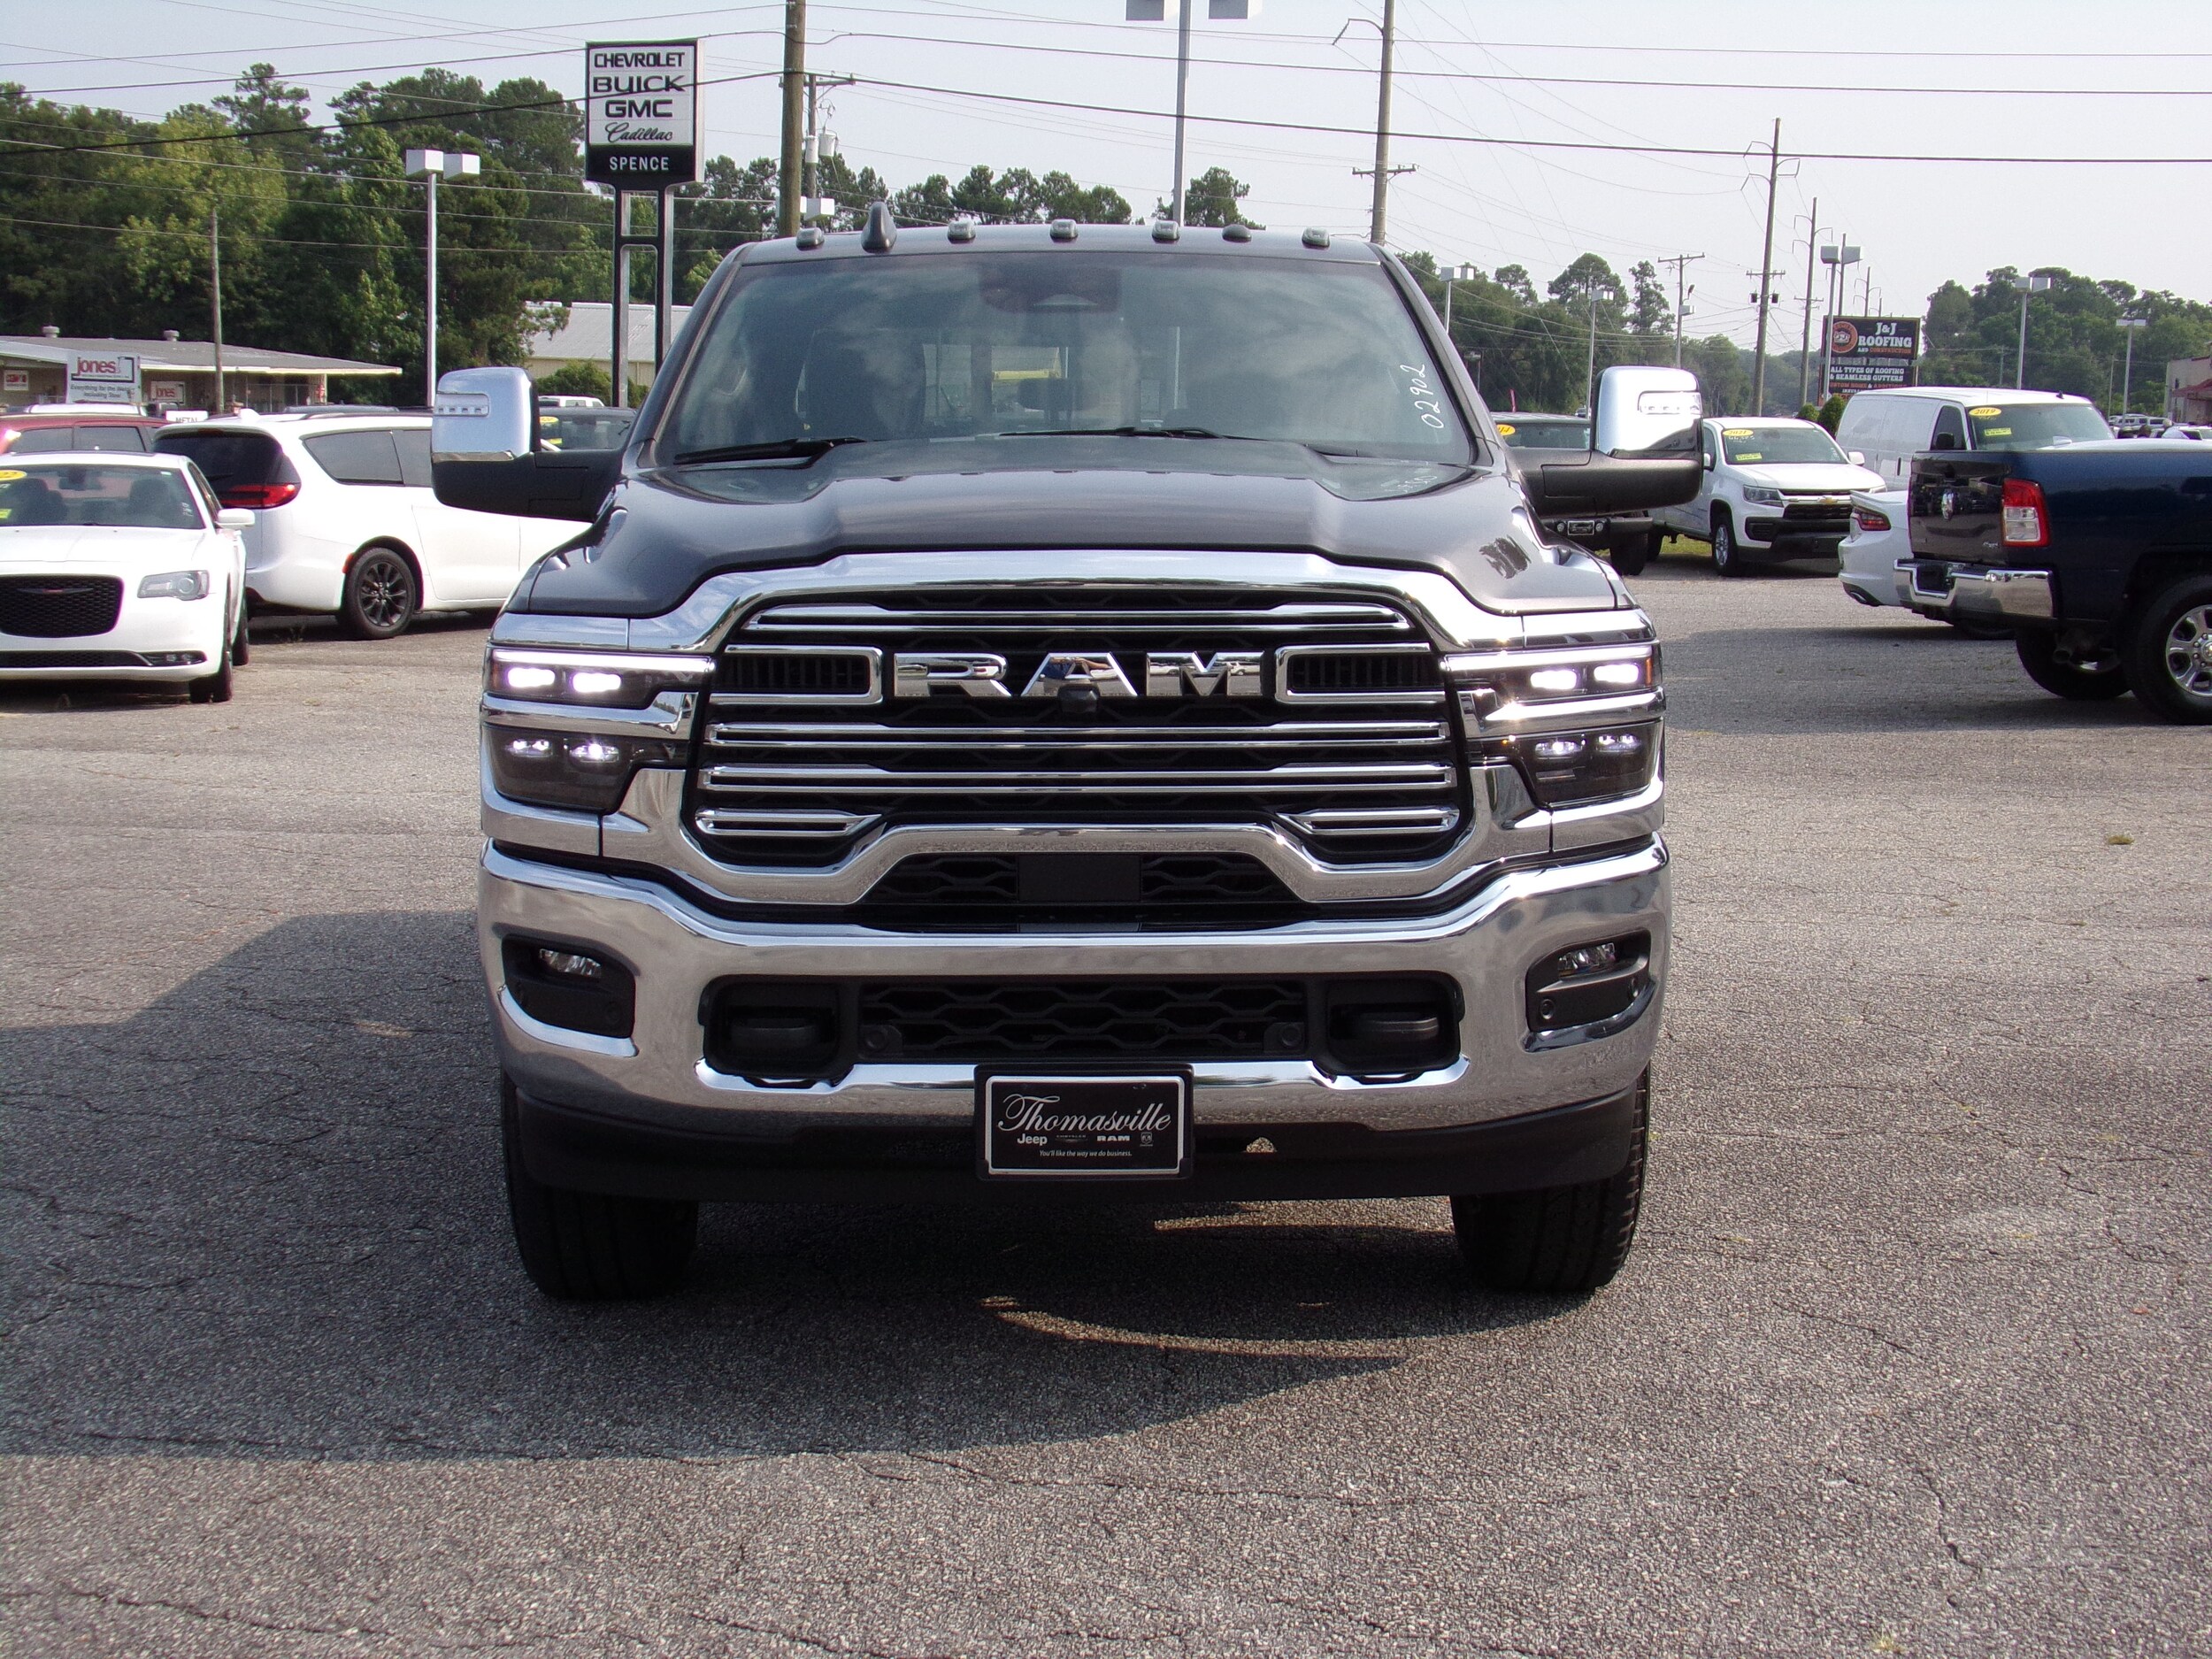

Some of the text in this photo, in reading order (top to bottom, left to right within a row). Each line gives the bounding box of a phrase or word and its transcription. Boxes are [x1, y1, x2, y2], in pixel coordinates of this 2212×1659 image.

[594, 52, 686, 68] CHEVROLET
[593, 75, 686, 93] BUICK
[604, 99, 673, 118] GMC
[604, 122, 673, 143] Cadillac
[609, 157, 669, 171] SPENCE
[1875, 322, 1898, 335] J&J
[1857, 335, 1912, 348] ROOFING
[77, 357, 116, 376] jones
[1400, 364, 1444, 428] 02902
[894, 651, 1264, 697] RAM
[997, 1094, 1171, 1132] Thomasville
[1017, 1133, 1048, 1147] Jeep
